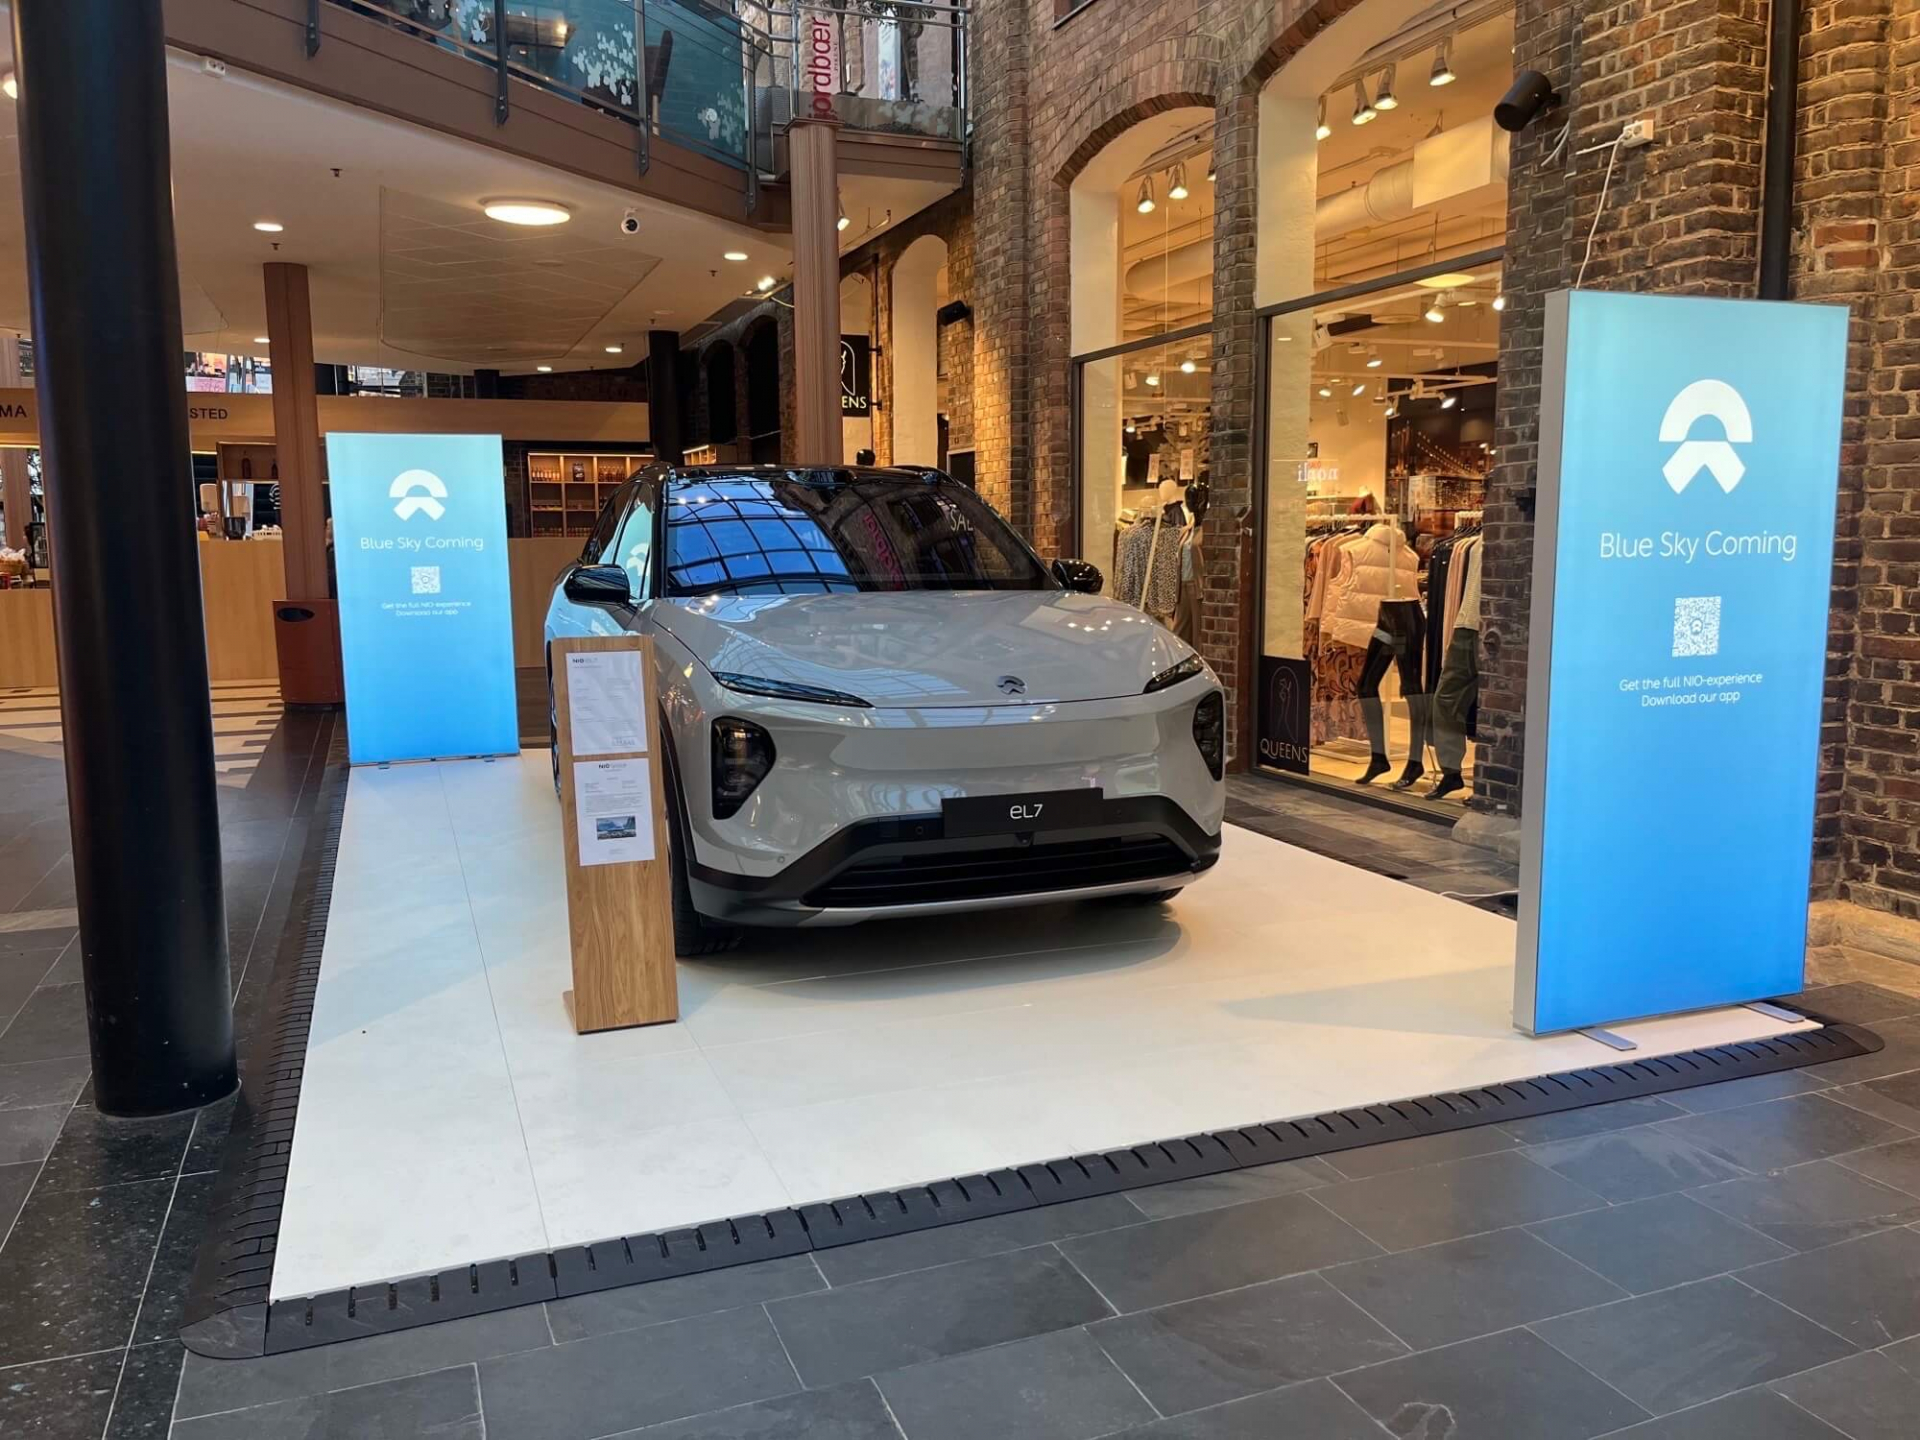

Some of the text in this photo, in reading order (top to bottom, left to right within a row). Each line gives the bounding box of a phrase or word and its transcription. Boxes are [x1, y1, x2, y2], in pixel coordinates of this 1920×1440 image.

[189, 408, 228, 420] STED
[360, 535, 484, 553] Blue Sky Coming
[1600, 530, 1797, 564] Blue Sky Coming
[1619, 672, 1763, 691] Get the full NIO-experience
[1641, 690, 1741, 707] Download our app
[1260, 738, 1308, 763] QUEENS
